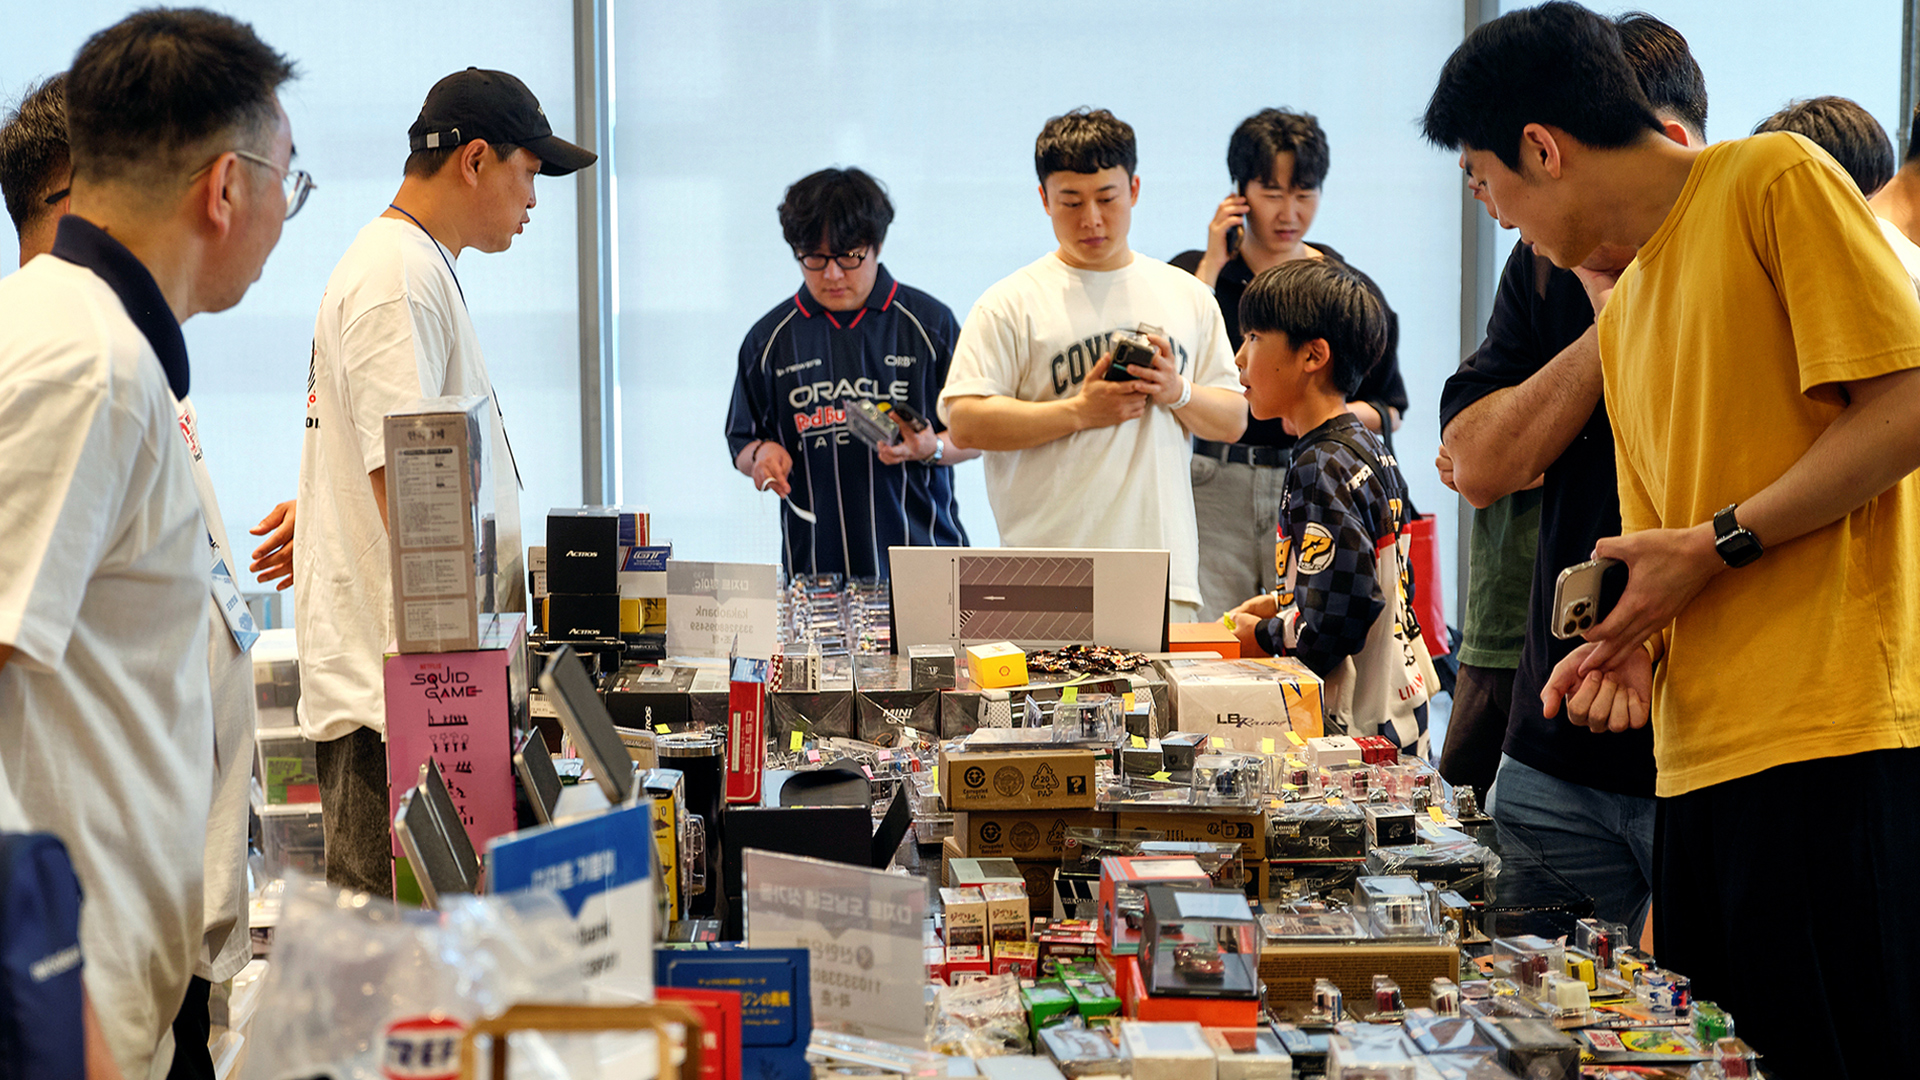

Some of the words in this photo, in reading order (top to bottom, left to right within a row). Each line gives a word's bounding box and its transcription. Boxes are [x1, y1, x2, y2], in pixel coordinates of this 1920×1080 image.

[788, 377, 909, 408] ORACLE
[824, 405, 847, 427] Bu
[410, 666, 470, 690] SQUID
[424, 685, 483, 703] GAME
[882, 708, 913, 717] MINI
[1216, 713, 1240, 724] LB
[1037, 789, 1054, 797] PAP
